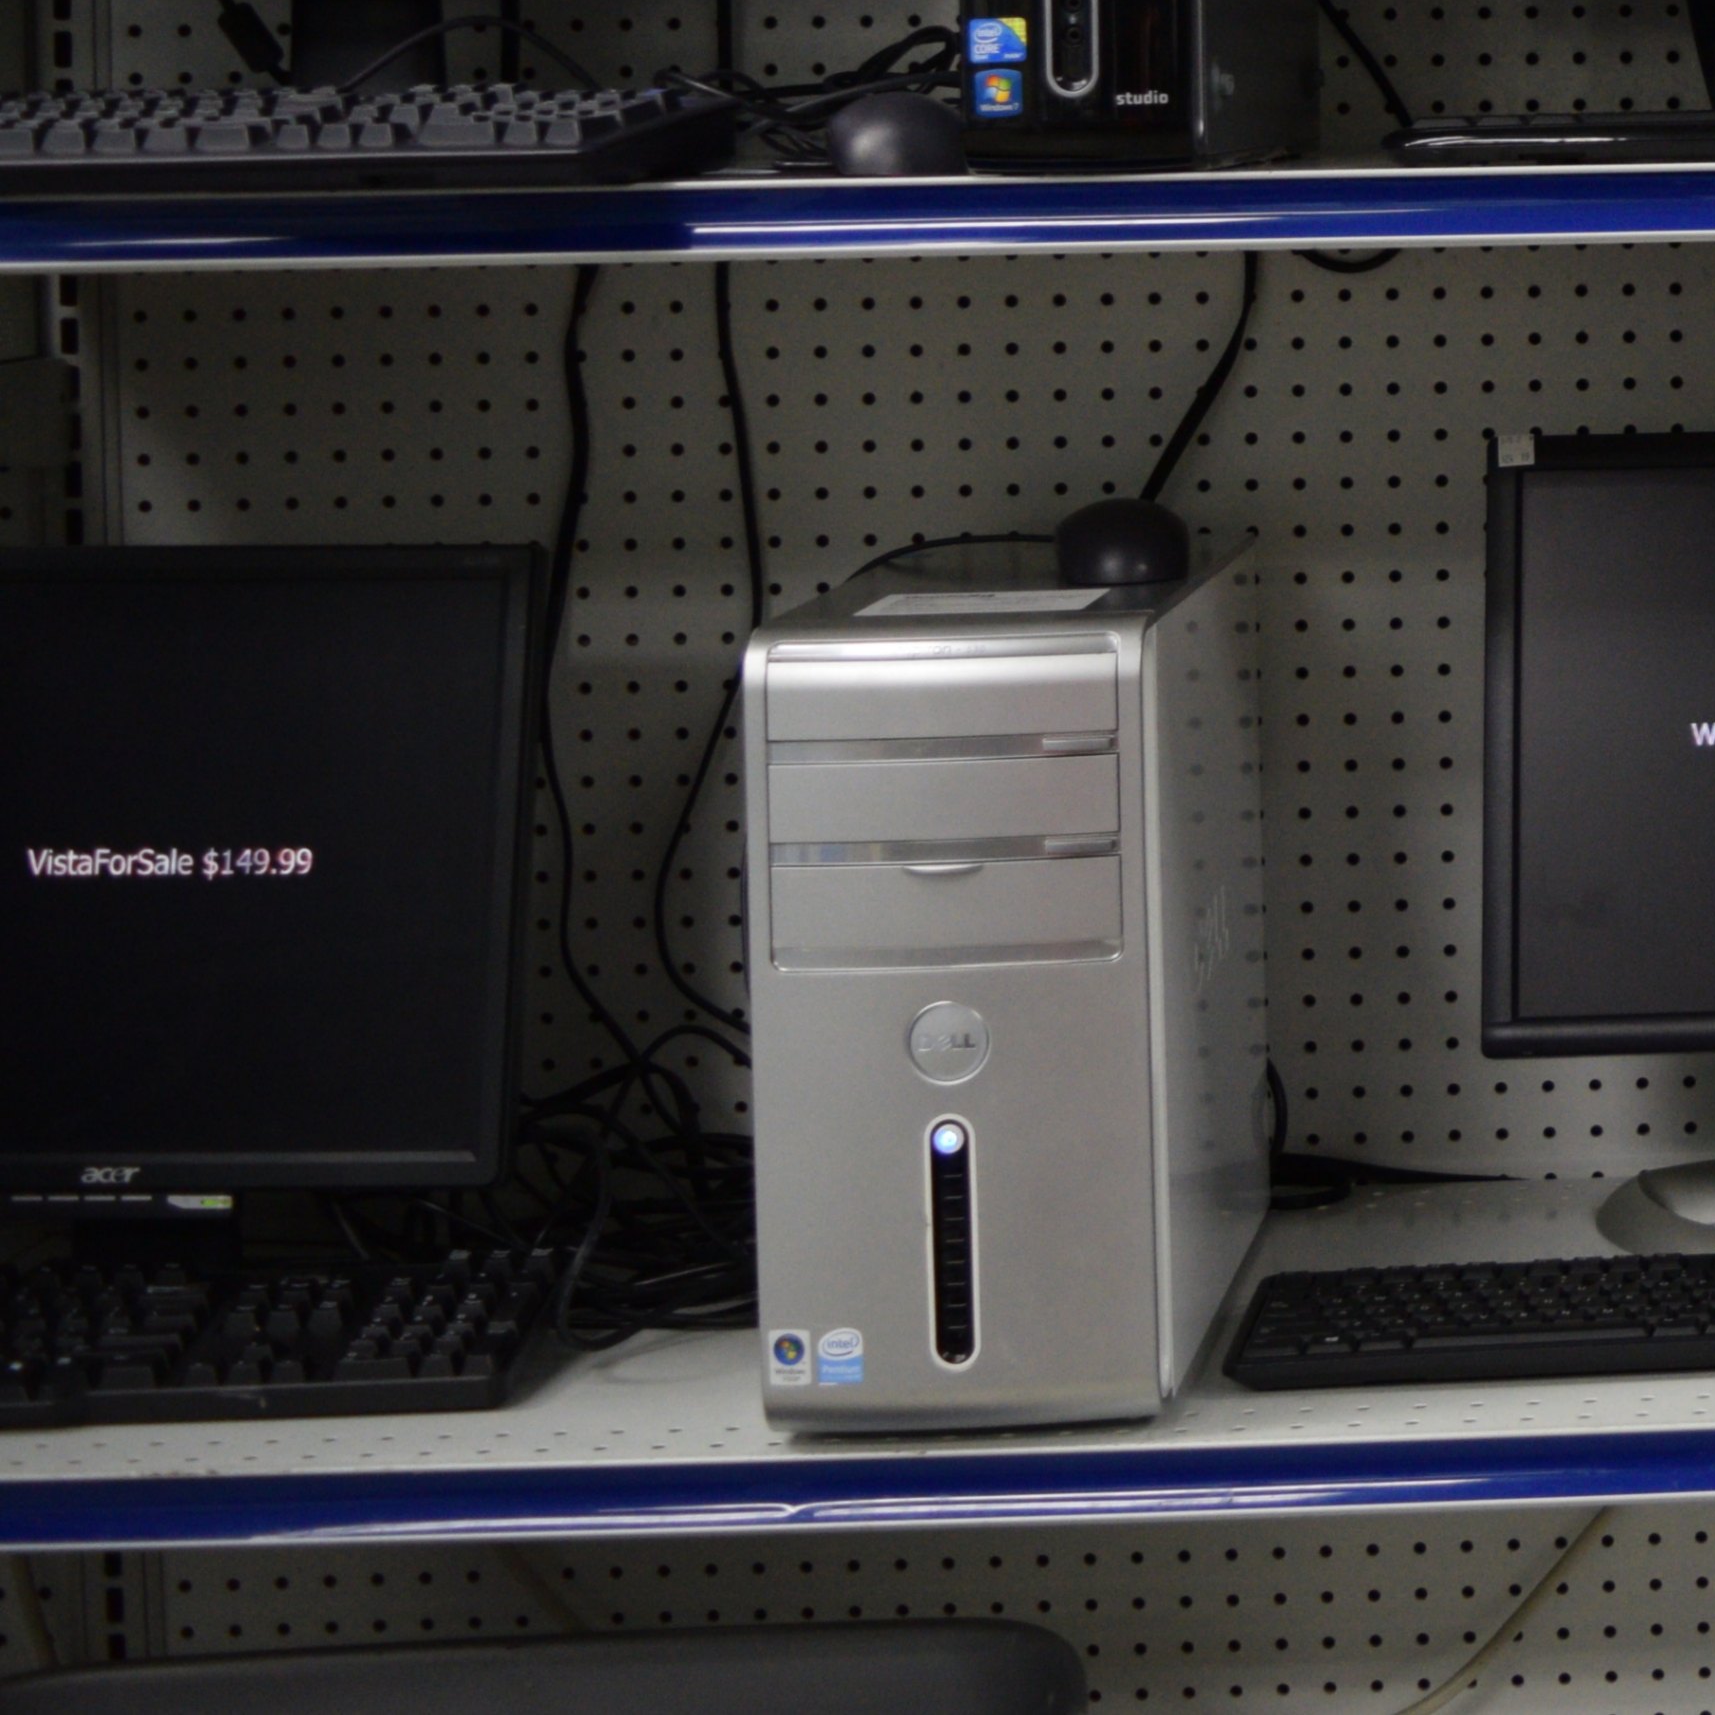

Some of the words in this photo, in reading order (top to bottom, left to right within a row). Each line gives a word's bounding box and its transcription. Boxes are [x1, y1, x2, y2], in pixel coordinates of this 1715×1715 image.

[1115, 89, 1169, 106] studio
[26, 847, 195, 877] VistaForSale
[201, 846, 314, 881] $149.99
[80, 1166, 142, 1185] acer
[826, 1339, 856, 1353] intel
